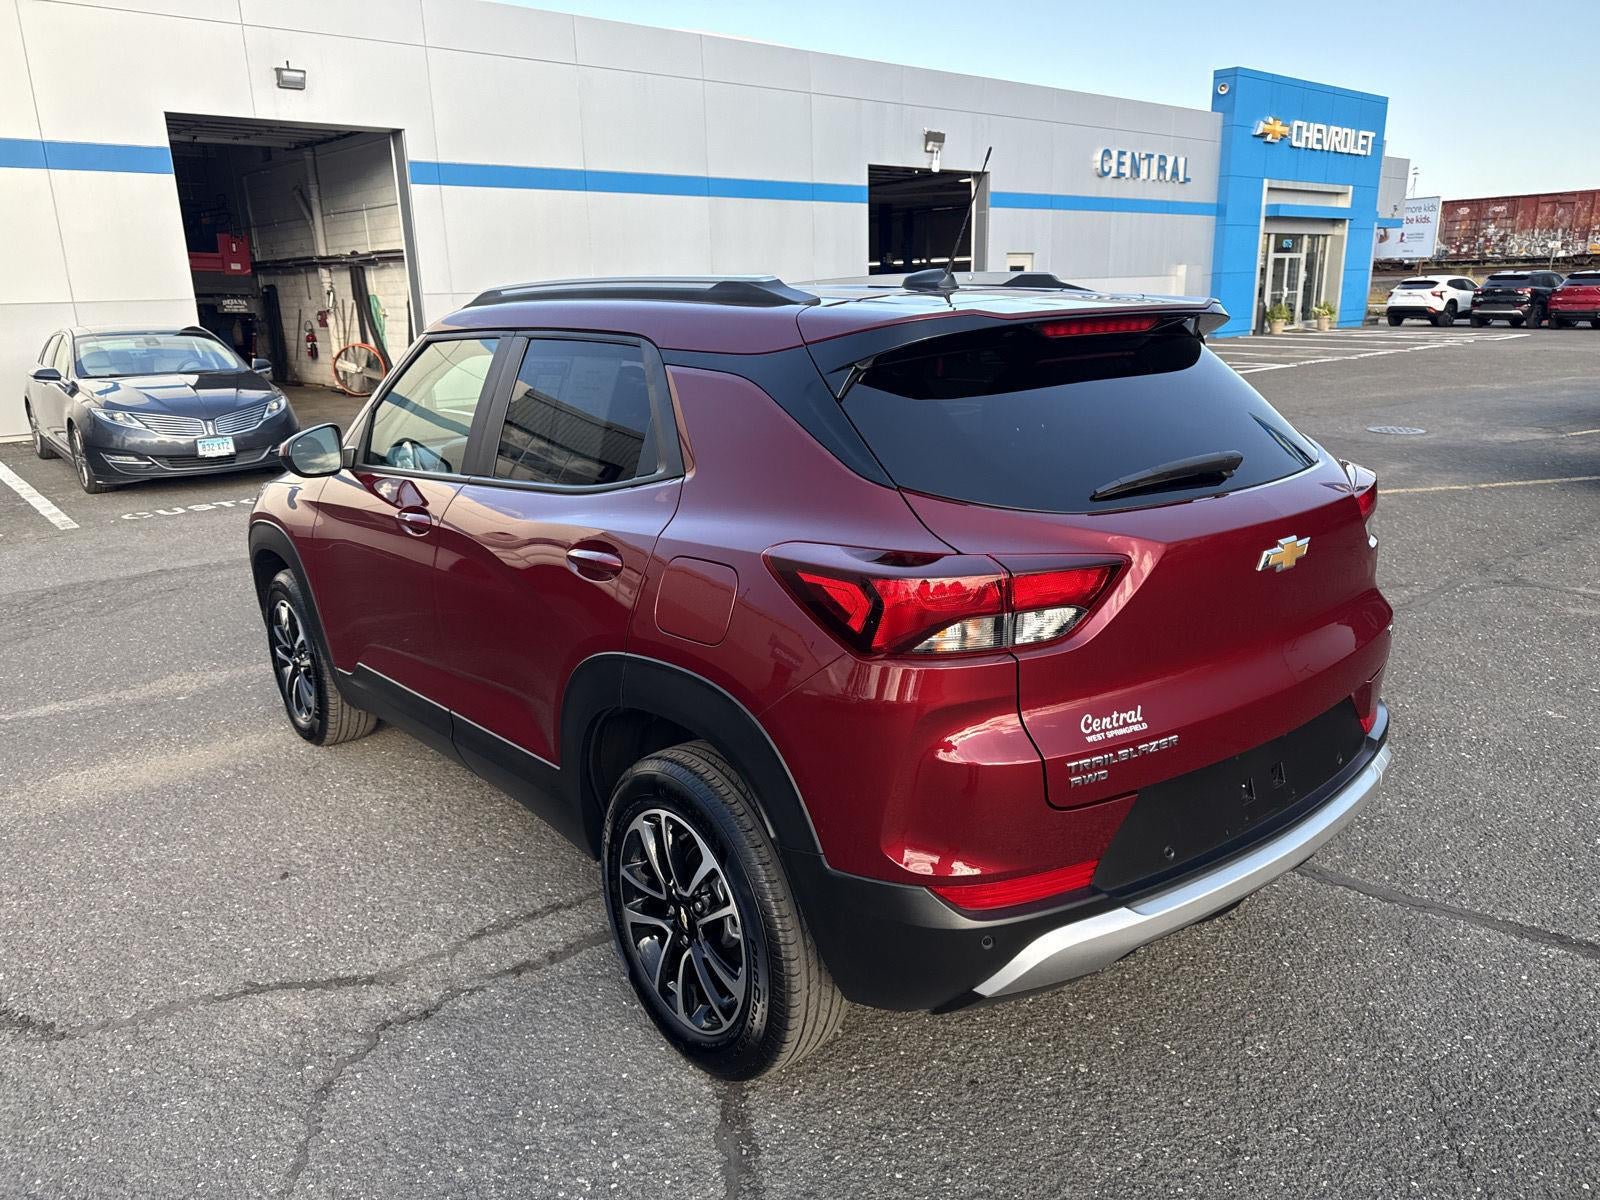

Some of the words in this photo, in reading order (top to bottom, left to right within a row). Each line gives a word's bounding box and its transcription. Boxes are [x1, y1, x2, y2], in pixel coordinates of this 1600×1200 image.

[1291, 120, 1376, 156] CHEVROLET
[1098, 147, 1192, 184] CENTRAL
[1405, 216, 1414, 224] be
[1423, 203, 1437, 212] kids
[1080, 704, 1143, 734] Central
[1085, 732, 1105, 743] WEST
[1105, 722, 1148, 739] SPRINGFIELD
[1066, 735, 1180, 774] TRAILBLAZER
[1069, 770, 1108, 789] AWD
